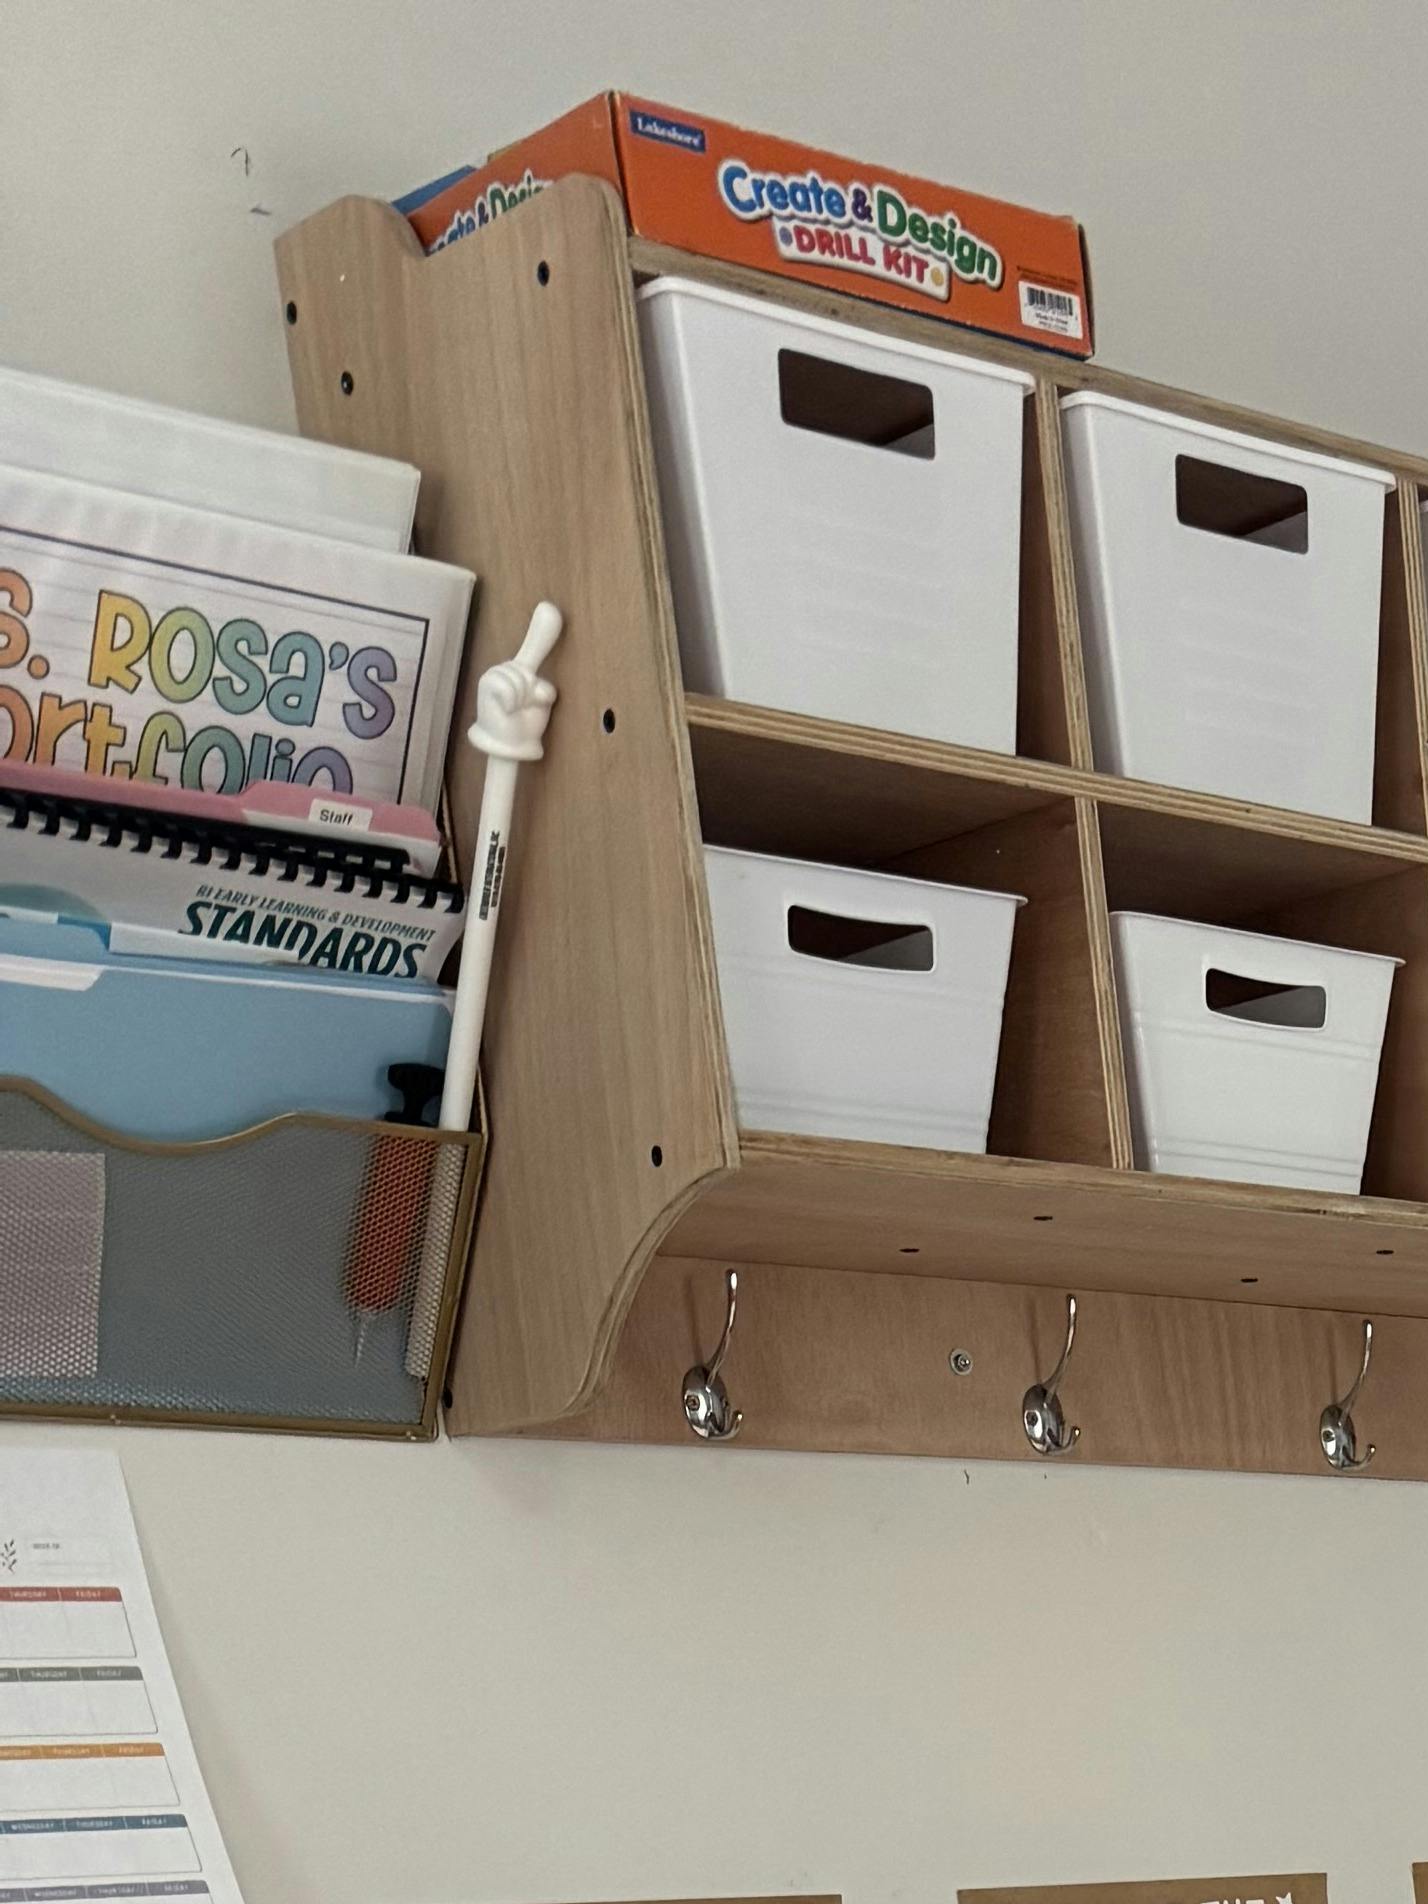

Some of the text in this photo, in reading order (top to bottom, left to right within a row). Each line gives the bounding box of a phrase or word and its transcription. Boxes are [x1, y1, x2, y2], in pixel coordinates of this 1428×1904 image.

[722, 164, 998, 283] Create & Design
[793, 226, 929, 283] DRILL KIT
[319, 809, 353, 826] Staff
[178, 901, 426, 979] STANDARDS
[212, 888, 256, 905] EARLY
[259, 896, 326, 922] LEARNING
[328, 911, 340, 923] &
[342, 913, 436, 940] DEVELOPMENT
